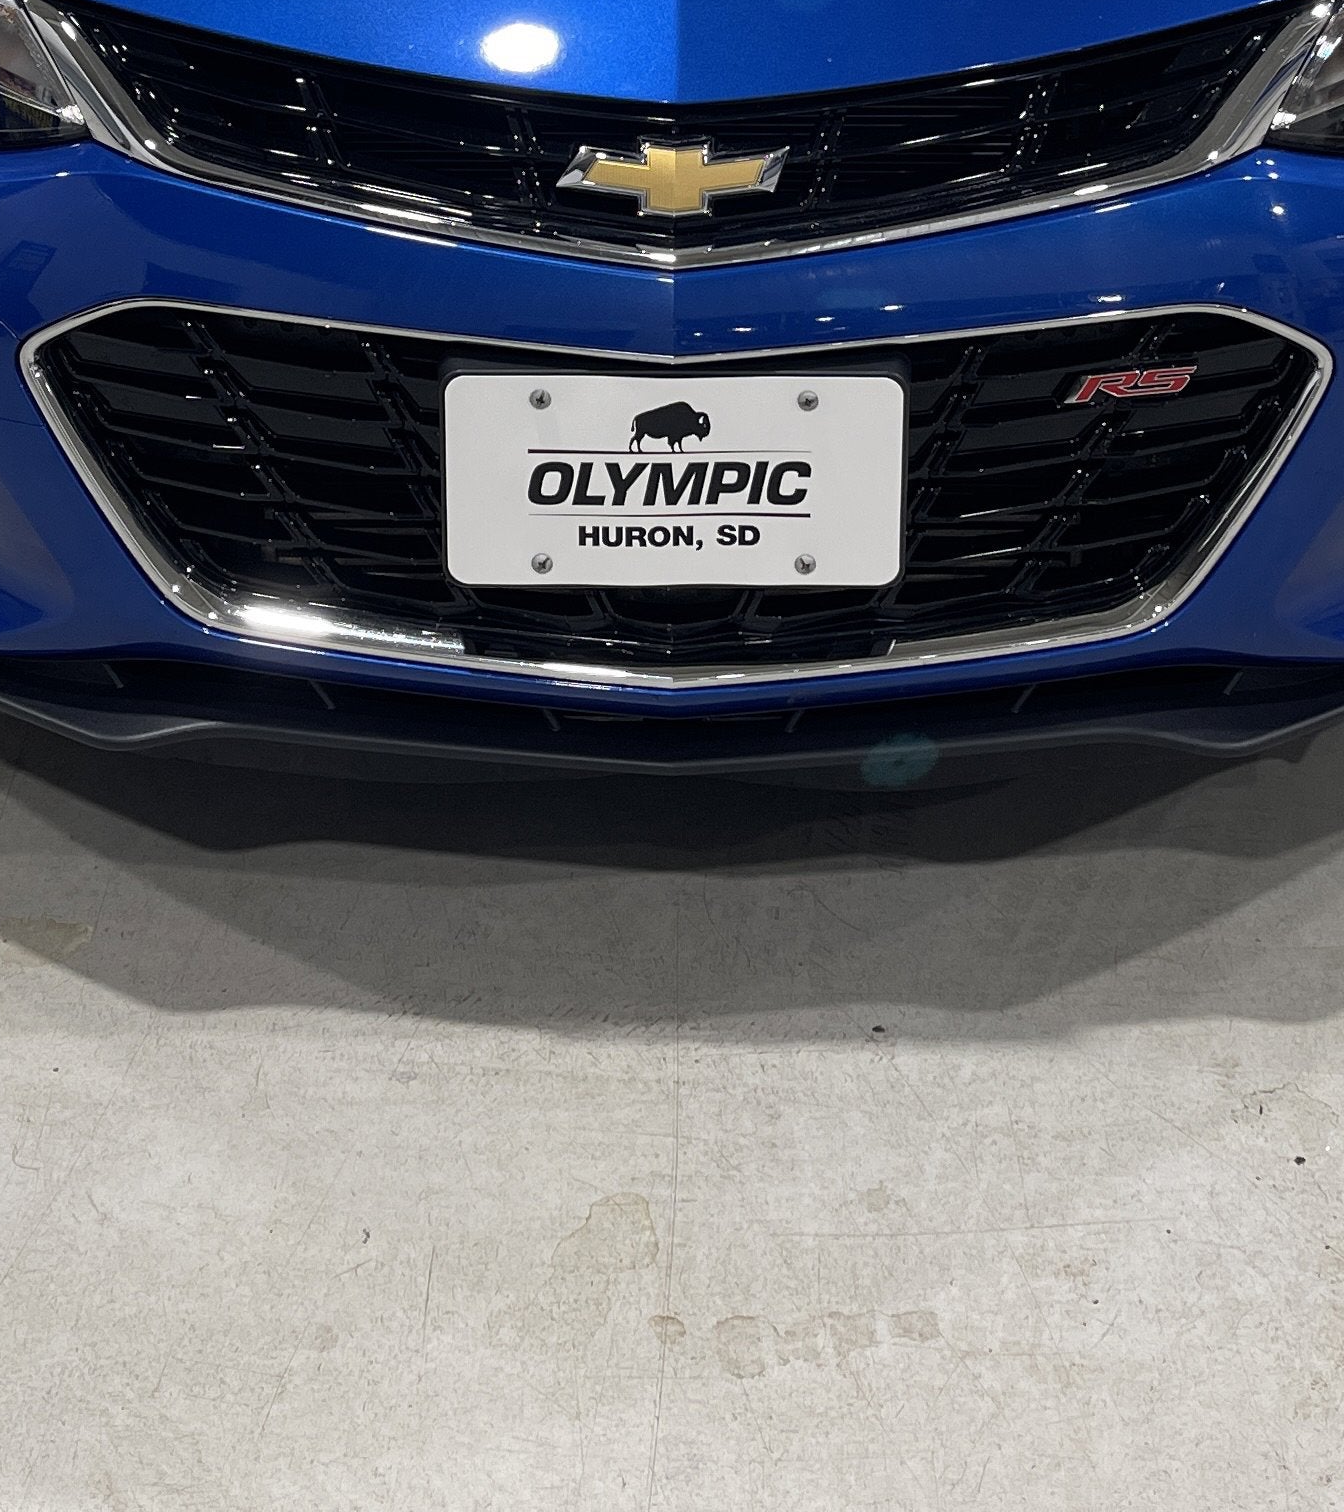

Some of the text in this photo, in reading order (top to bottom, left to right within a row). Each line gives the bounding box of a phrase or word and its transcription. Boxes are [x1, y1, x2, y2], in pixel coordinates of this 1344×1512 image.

[1064, 365, 1197, 403] RS
[527, 461, 812, 506] OLYMPIC
[578, 524, 761, 550] HURON, SD
